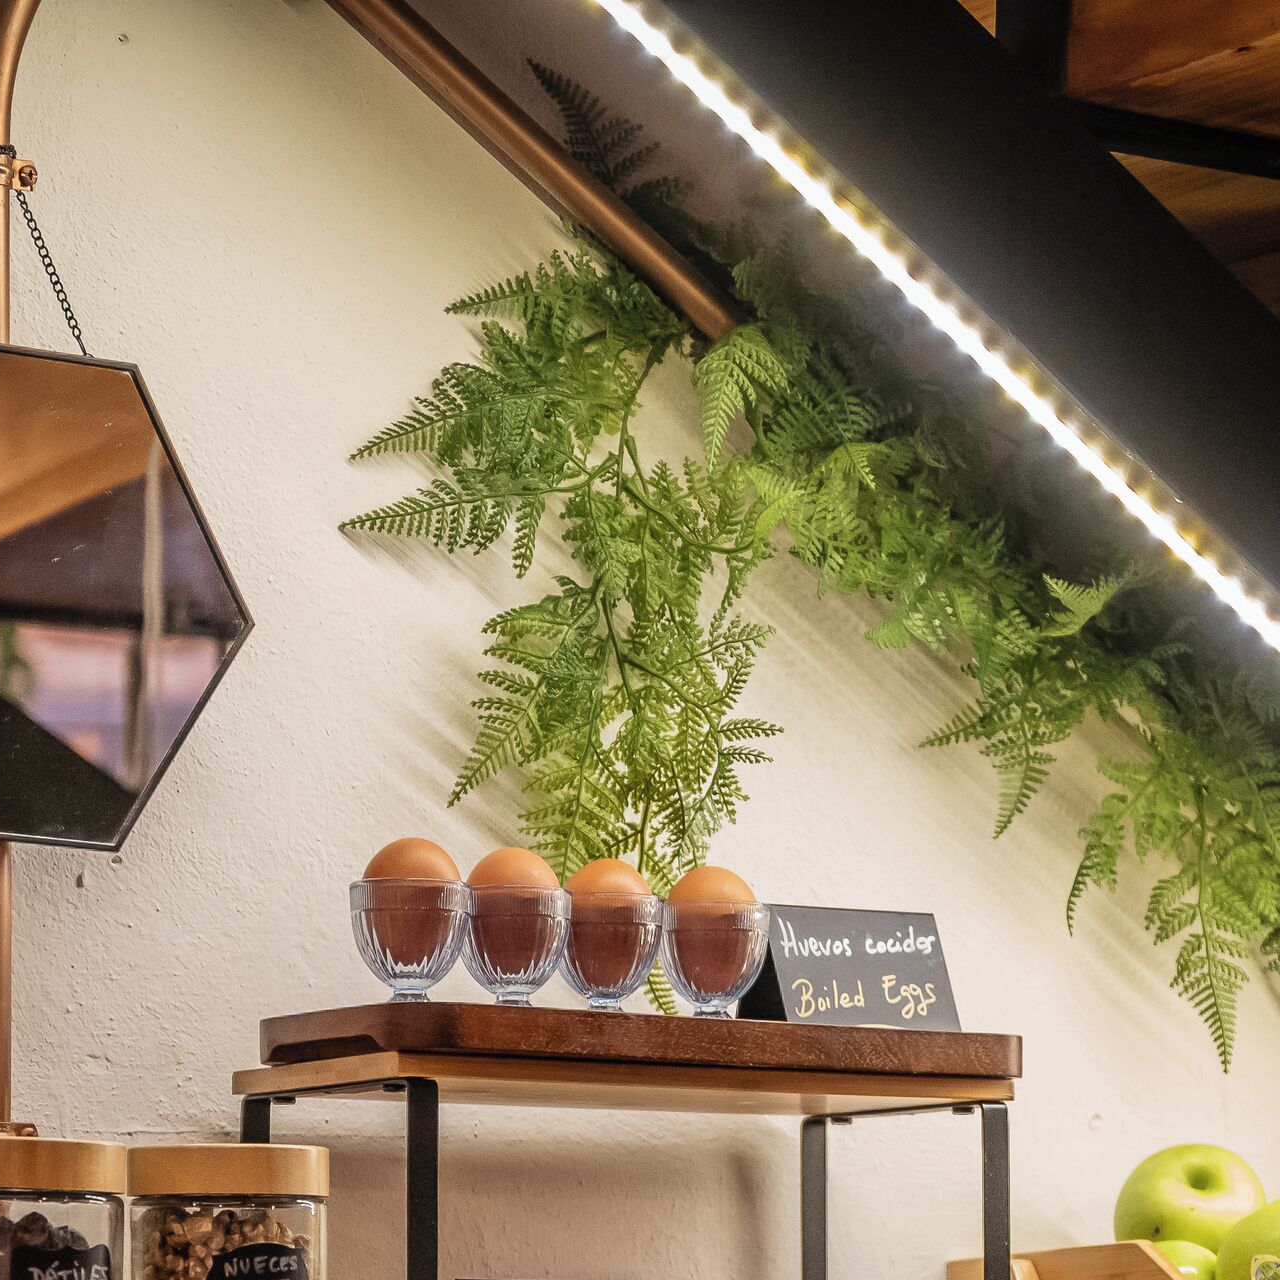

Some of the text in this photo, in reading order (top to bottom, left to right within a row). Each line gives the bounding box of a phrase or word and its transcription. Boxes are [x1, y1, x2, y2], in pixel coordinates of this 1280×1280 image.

[776, 916, 852, 958] Huevos
[791, 974, 937, 1019] Boiled Eggs
[223, 1255, 298, 1278] NUECES
